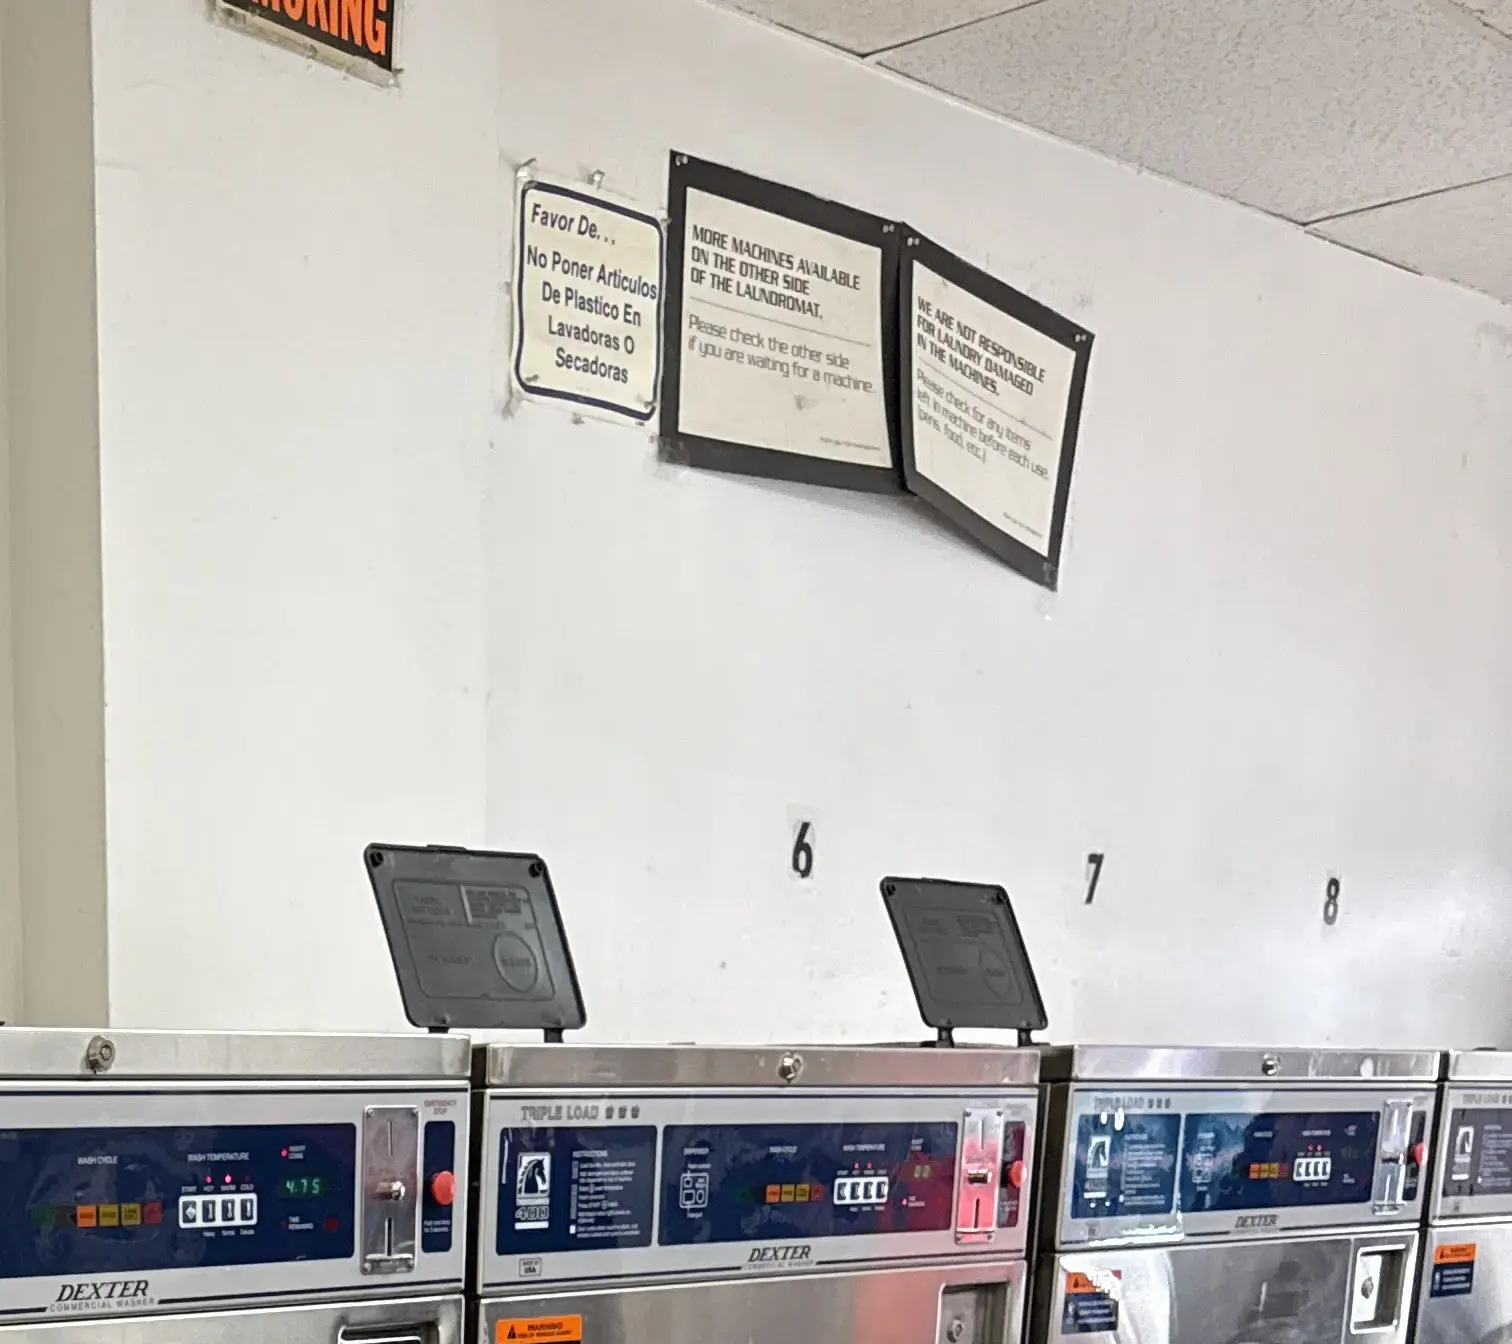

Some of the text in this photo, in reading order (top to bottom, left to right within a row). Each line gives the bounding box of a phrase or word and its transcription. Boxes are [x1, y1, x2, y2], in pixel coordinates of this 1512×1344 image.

[531, 203, 575, 232] Favor
[527, 245, 658, 300] No Poner Articulos
[691, 246, 810, 296] ON THE OTHER SIDE
[692, 224, 860, 291] MORE MACHINES AVAILABLE
[542, 281, 641, 326] De Plastico En
[690, 267, 824, 319] OF THE LAUNDROMAT.
[548, 315, 635, 355] Lavadoras O
[688, 313, 850, 370] Please check the other side
[688, 335, 697, 351] if
[699, 341, 722, 358] you
[724, 347, 745, 364] are
[747, 352, 790, 378] waiting
[792, 361, 809, 379] for
[812, 368, 820, 381] a
[917, 295, 1046, 383] WE ARE NOT RESPONSIBLE
[917, 314, 1035, 396] FOR LAUNDRY DAMAGED
[555, 347, 628, 384] Secadoras
[917, 333, 1000, 396] IN THE MACHINES.
[917, 368, 1031, 451] Please check for any items
[933, 396, 942, 412] in
[942, 405, 977, 437] machine
[978, 427, 1007, 457] before
[1008, 444, 1030, 470] each
[792, 821, 813, 879] 6
[1084, 853, 1104, 905] 7
[1323, 877, 1340, 926] 8
[521, 1105, 600, 1121] TRIPLE LOAD
[515, 1206, 550, 1220] 400
[747, 1245, 811, 1262] DEXTER
[49, 1297, 155, 1312] COMMERCIAL WASHER
[55, 1280, 148, 1302] DEXTER
